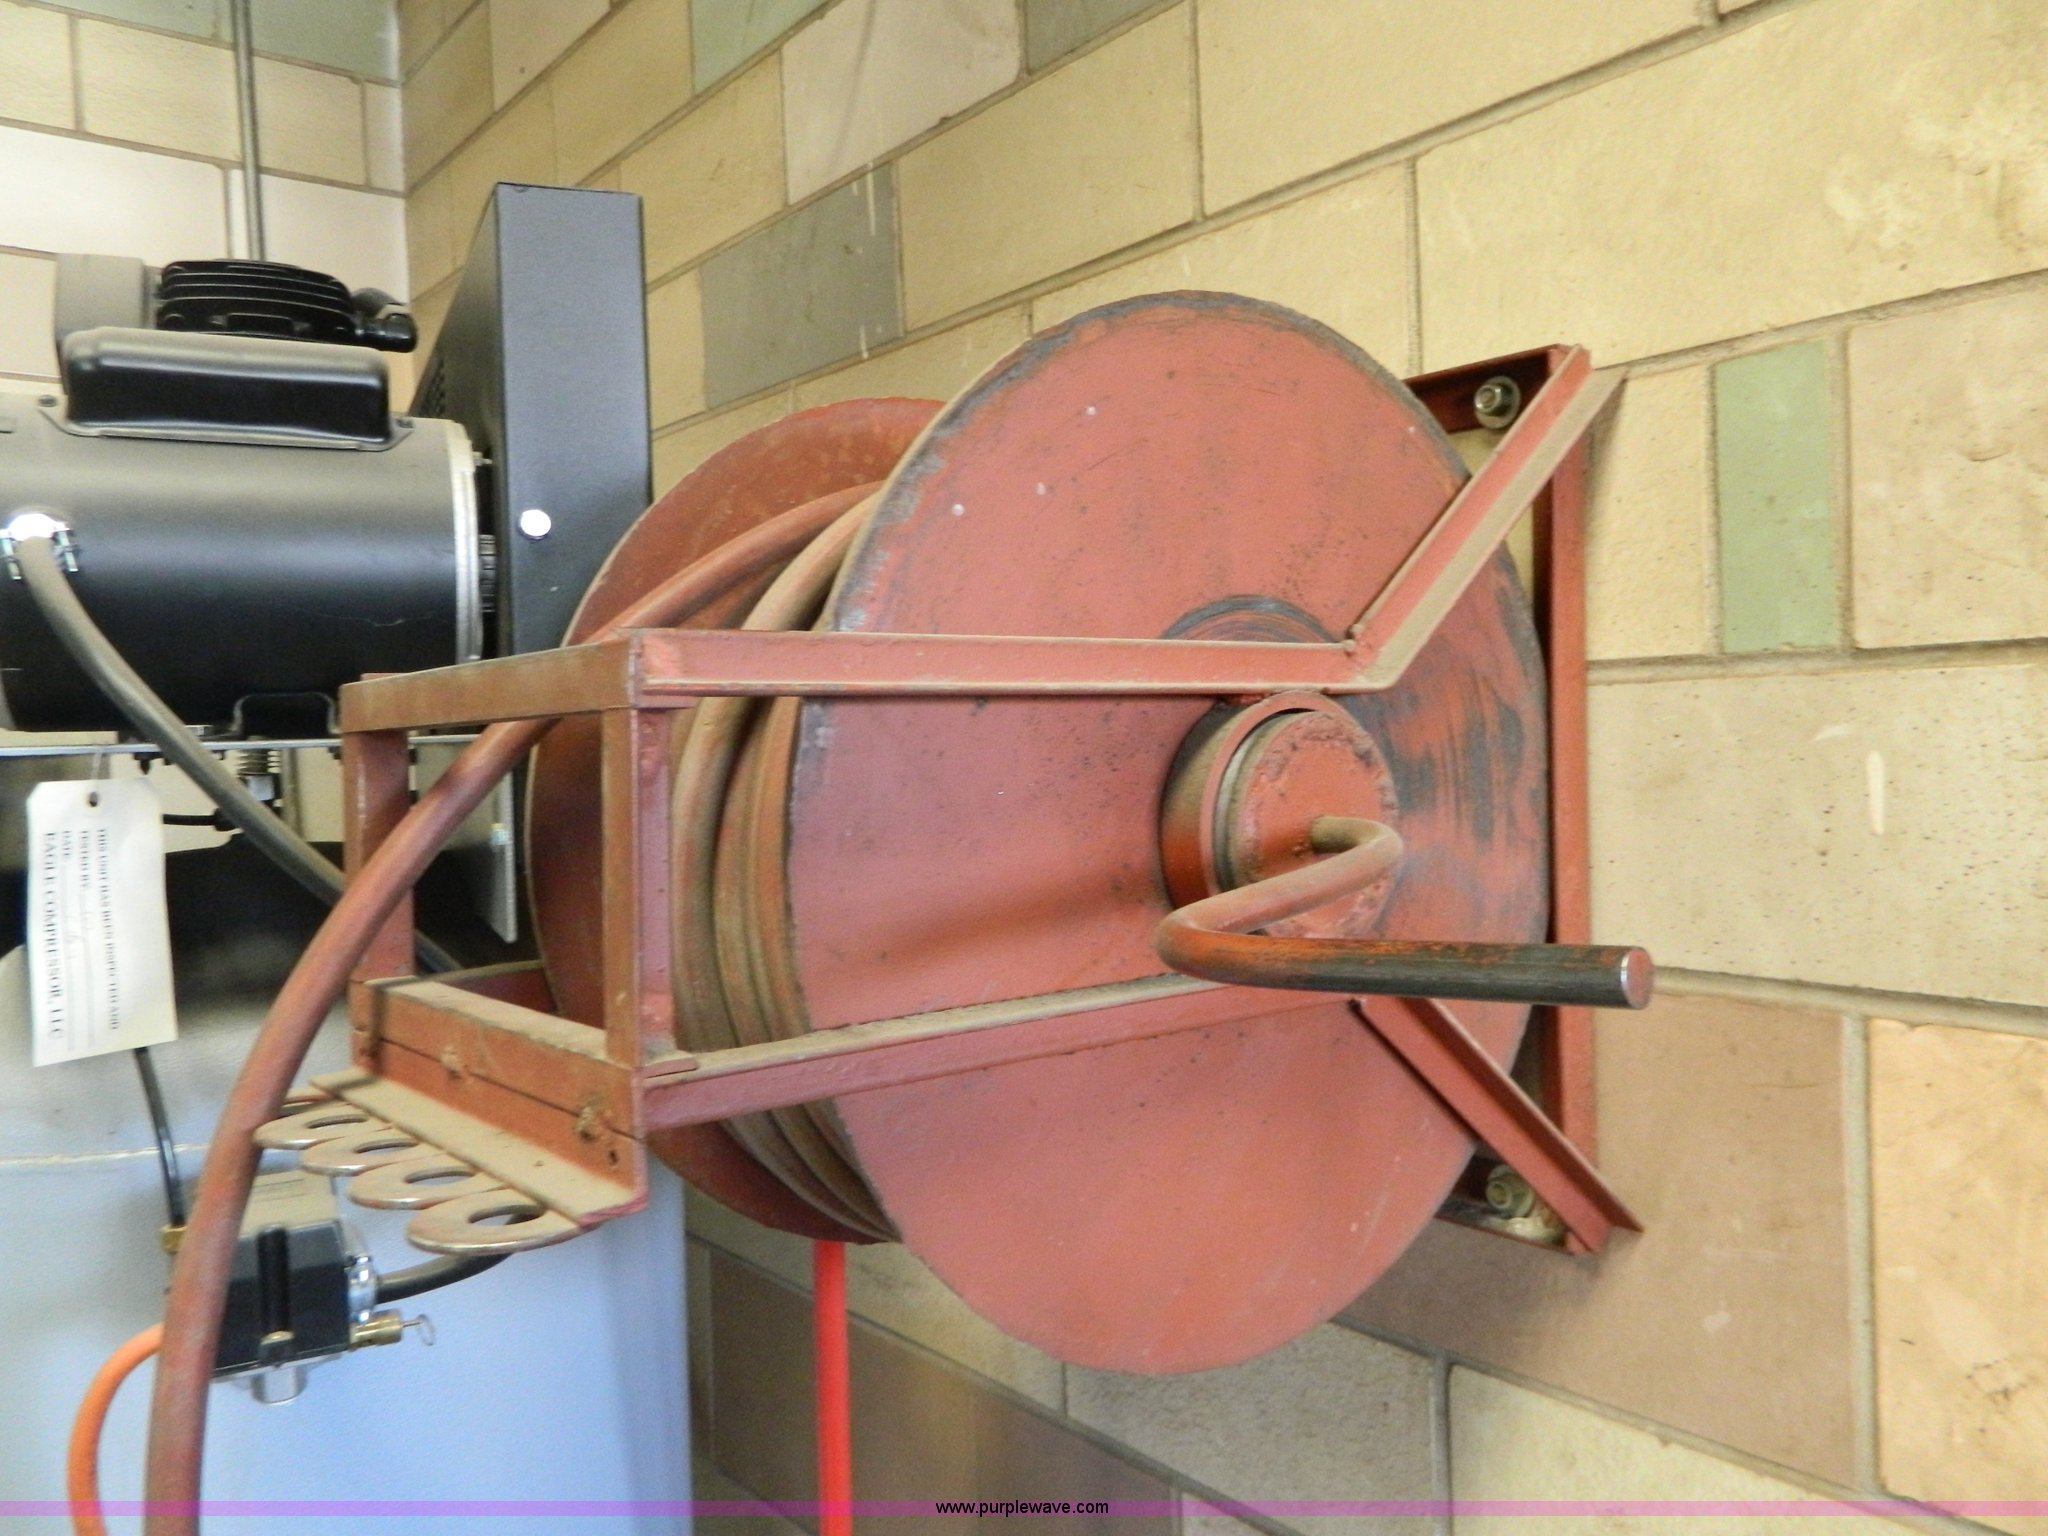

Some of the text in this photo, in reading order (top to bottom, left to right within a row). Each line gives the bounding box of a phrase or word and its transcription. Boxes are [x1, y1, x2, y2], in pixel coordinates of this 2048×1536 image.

[43, 833, 58, 885] EAGLE
[97, 829, 121, 1030] THIS UNIT HAS BEEN INSPECTED AND
[48, 1009, 64, 1039] LLC
